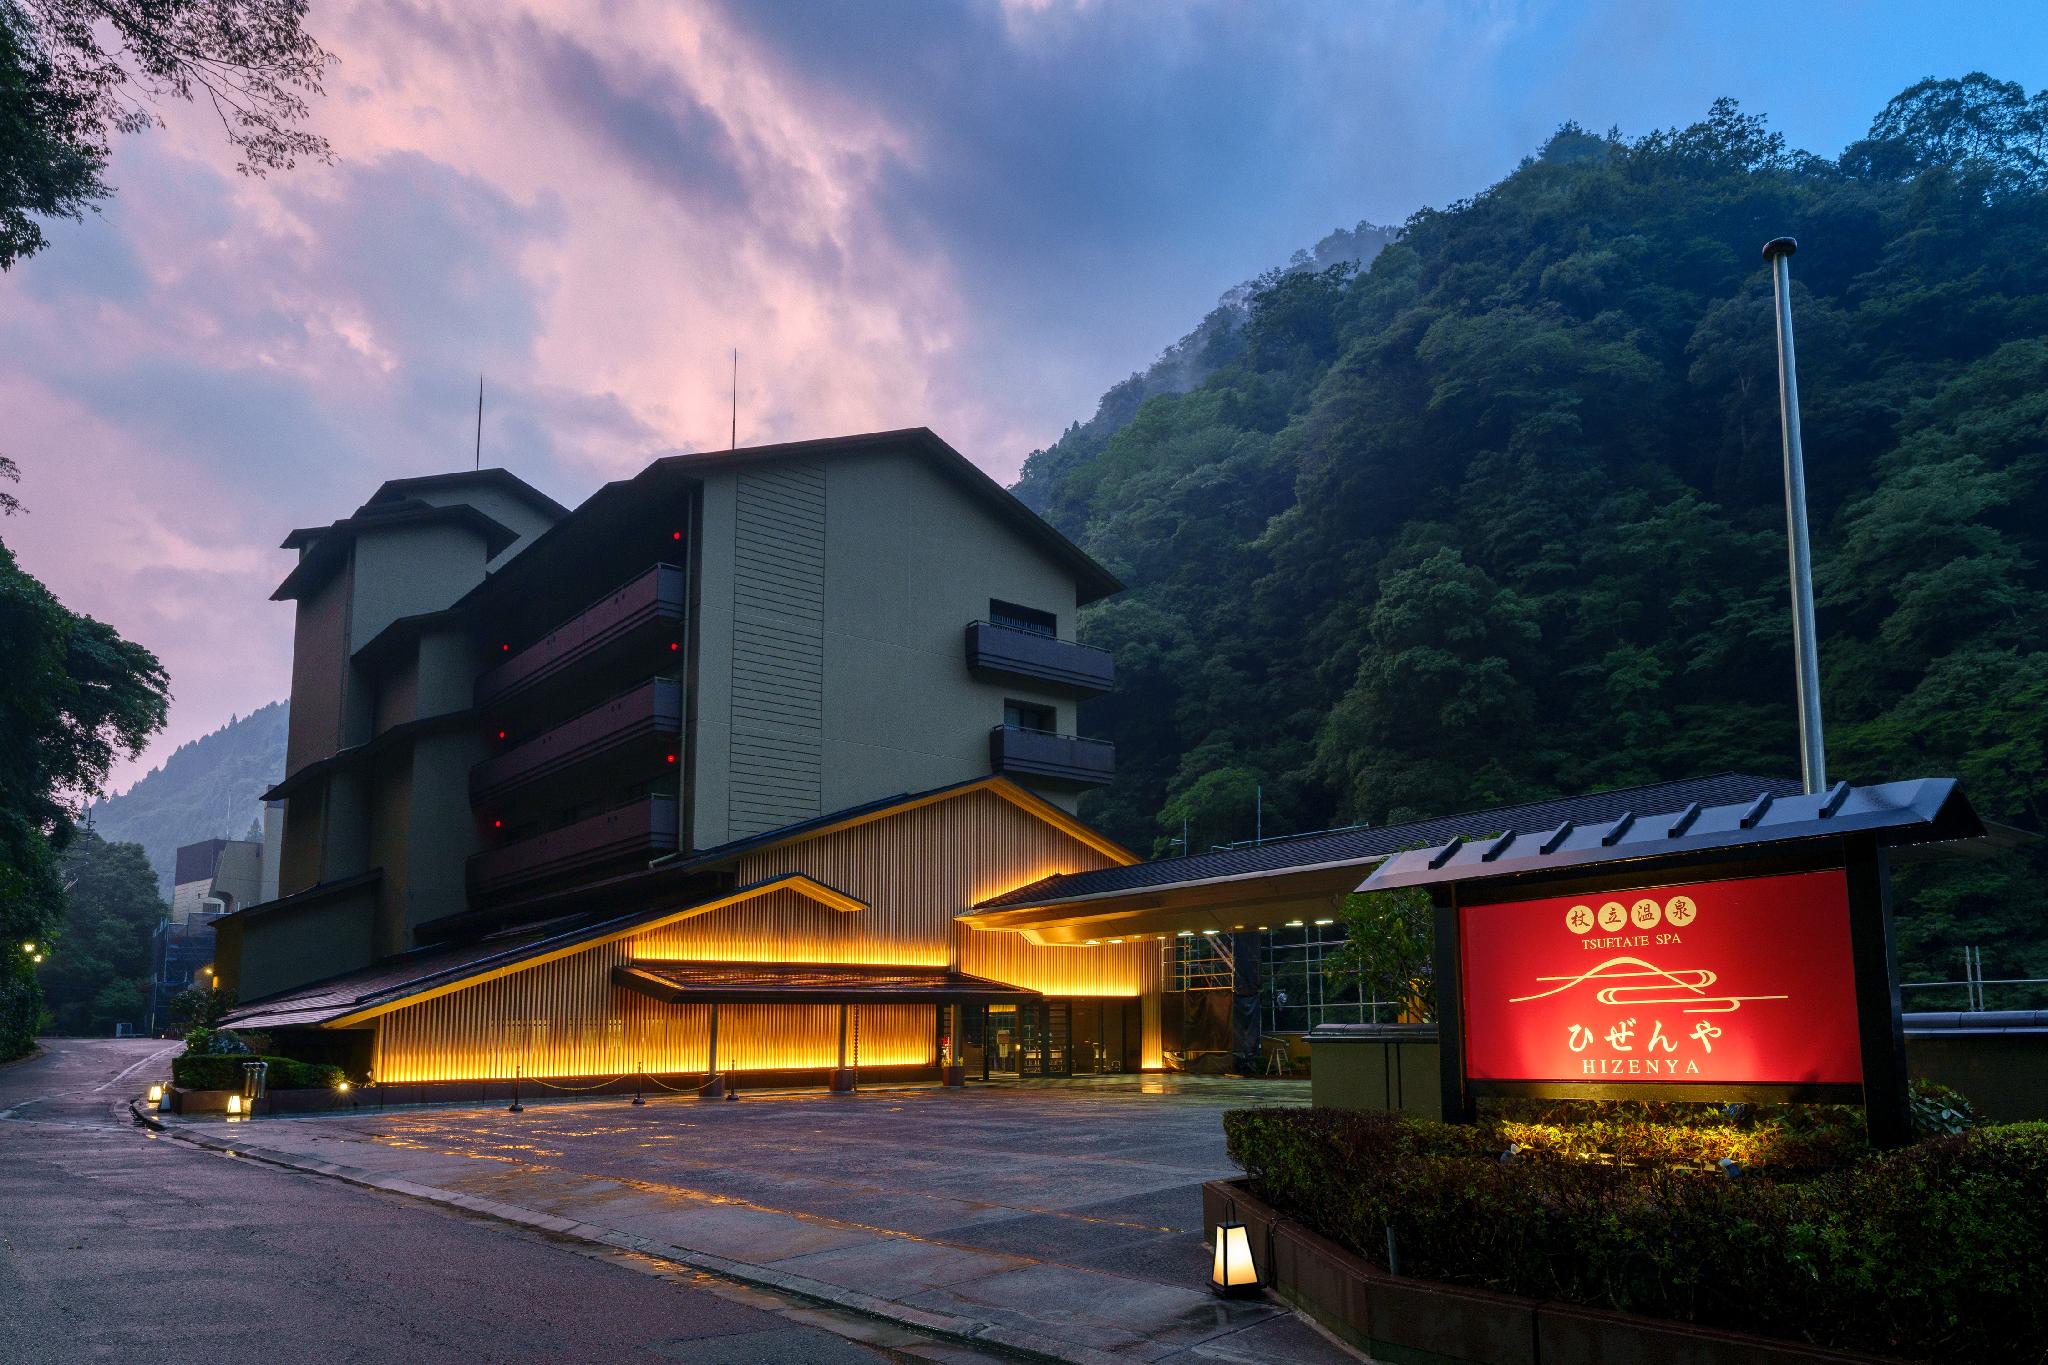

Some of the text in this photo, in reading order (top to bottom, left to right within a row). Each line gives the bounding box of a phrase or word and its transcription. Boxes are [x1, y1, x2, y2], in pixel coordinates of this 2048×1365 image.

[1568, 898, 1695, 931] 杖立温泉
[1583, 933, 1682, 950] TSUETATE SPA
[1567, 1017, 1722, 1053] ひぜんや
[1582, 1059, 1700, 1074] HIZENYA
